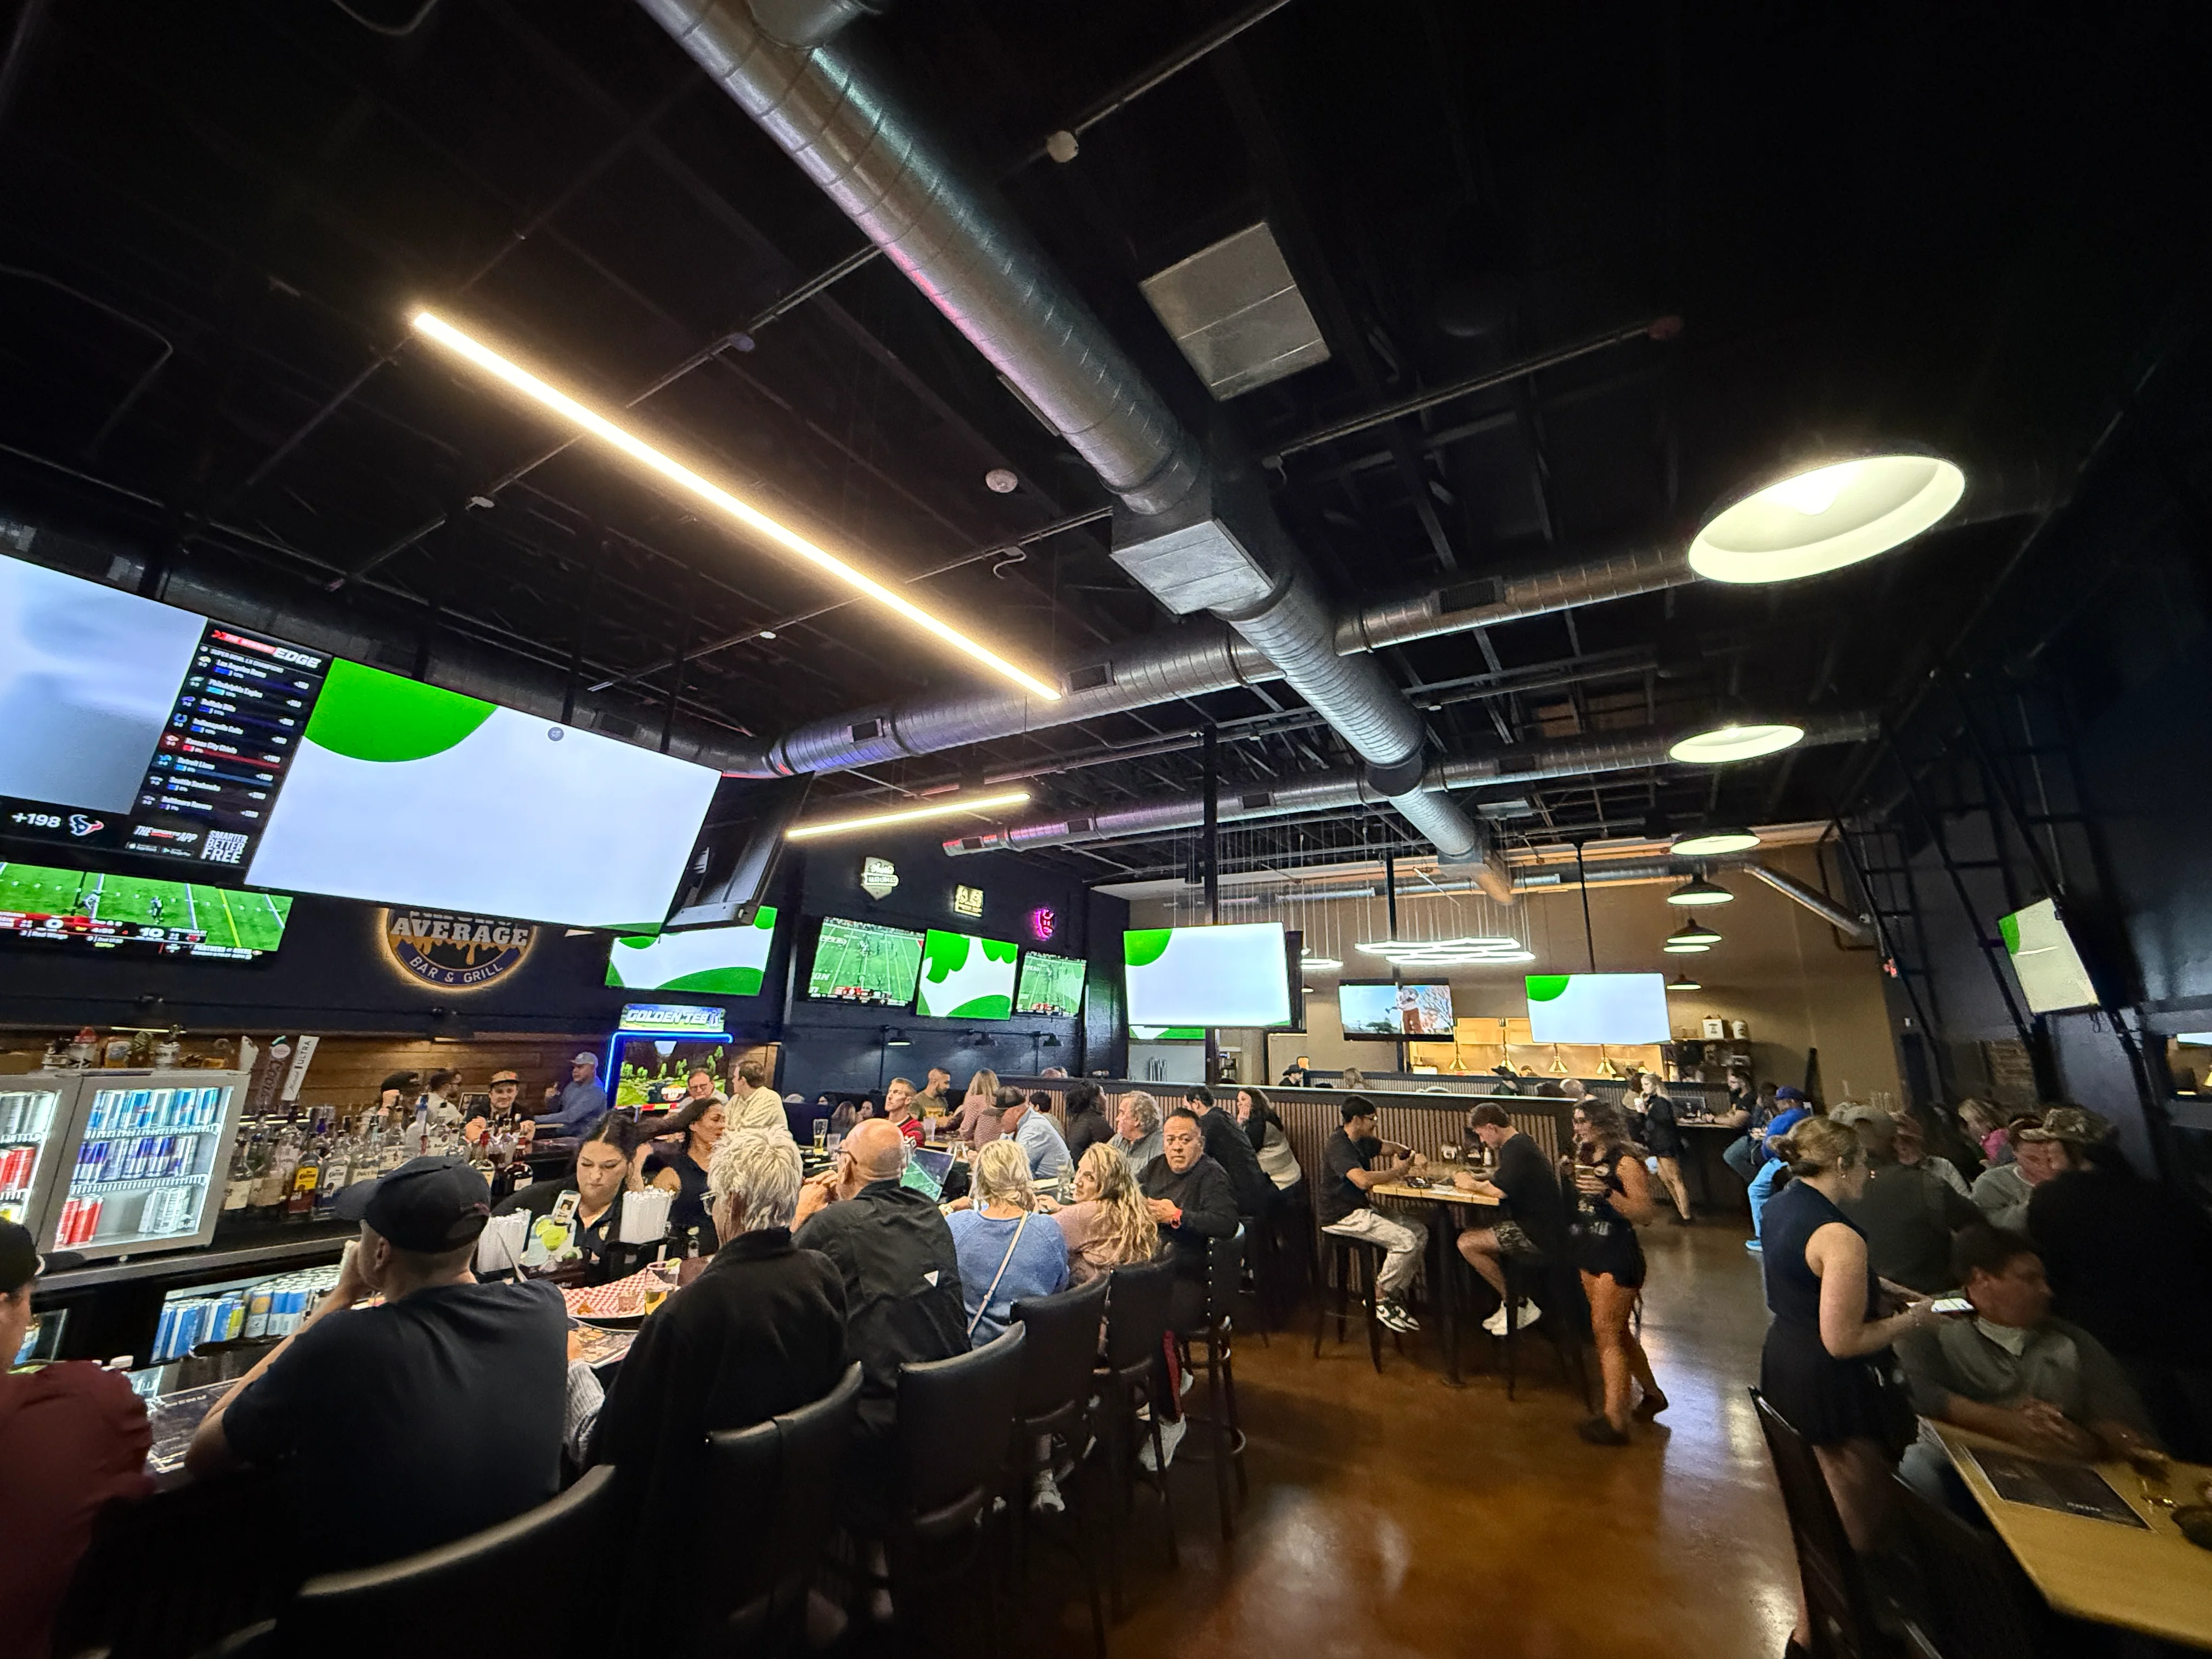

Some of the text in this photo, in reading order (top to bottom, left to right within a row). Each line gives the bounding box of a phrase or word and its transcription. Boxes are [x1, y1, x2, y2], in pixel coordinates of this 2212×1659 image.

[273, 647, 322, 669] EDGE
[12, 812, 61, 828] +198
[133, 825, 151, 837] THE
[176, 832, 199, 843] APP
[208, 830, 249, 844] SMARTER
[205, 838, 246, 855] BETTER
[200, 847, 241, 864] FREE
[44, 918, 65, 929] 0
[390, 917, 529, 947] AVERAGE
[139, 927, 165, 938] 10
[409, 956, 504, 983] BAR & GRILL
[625, 1009, 682, 1024] GOLDEN
[297, 1040, 312, 1065] ULTRA
